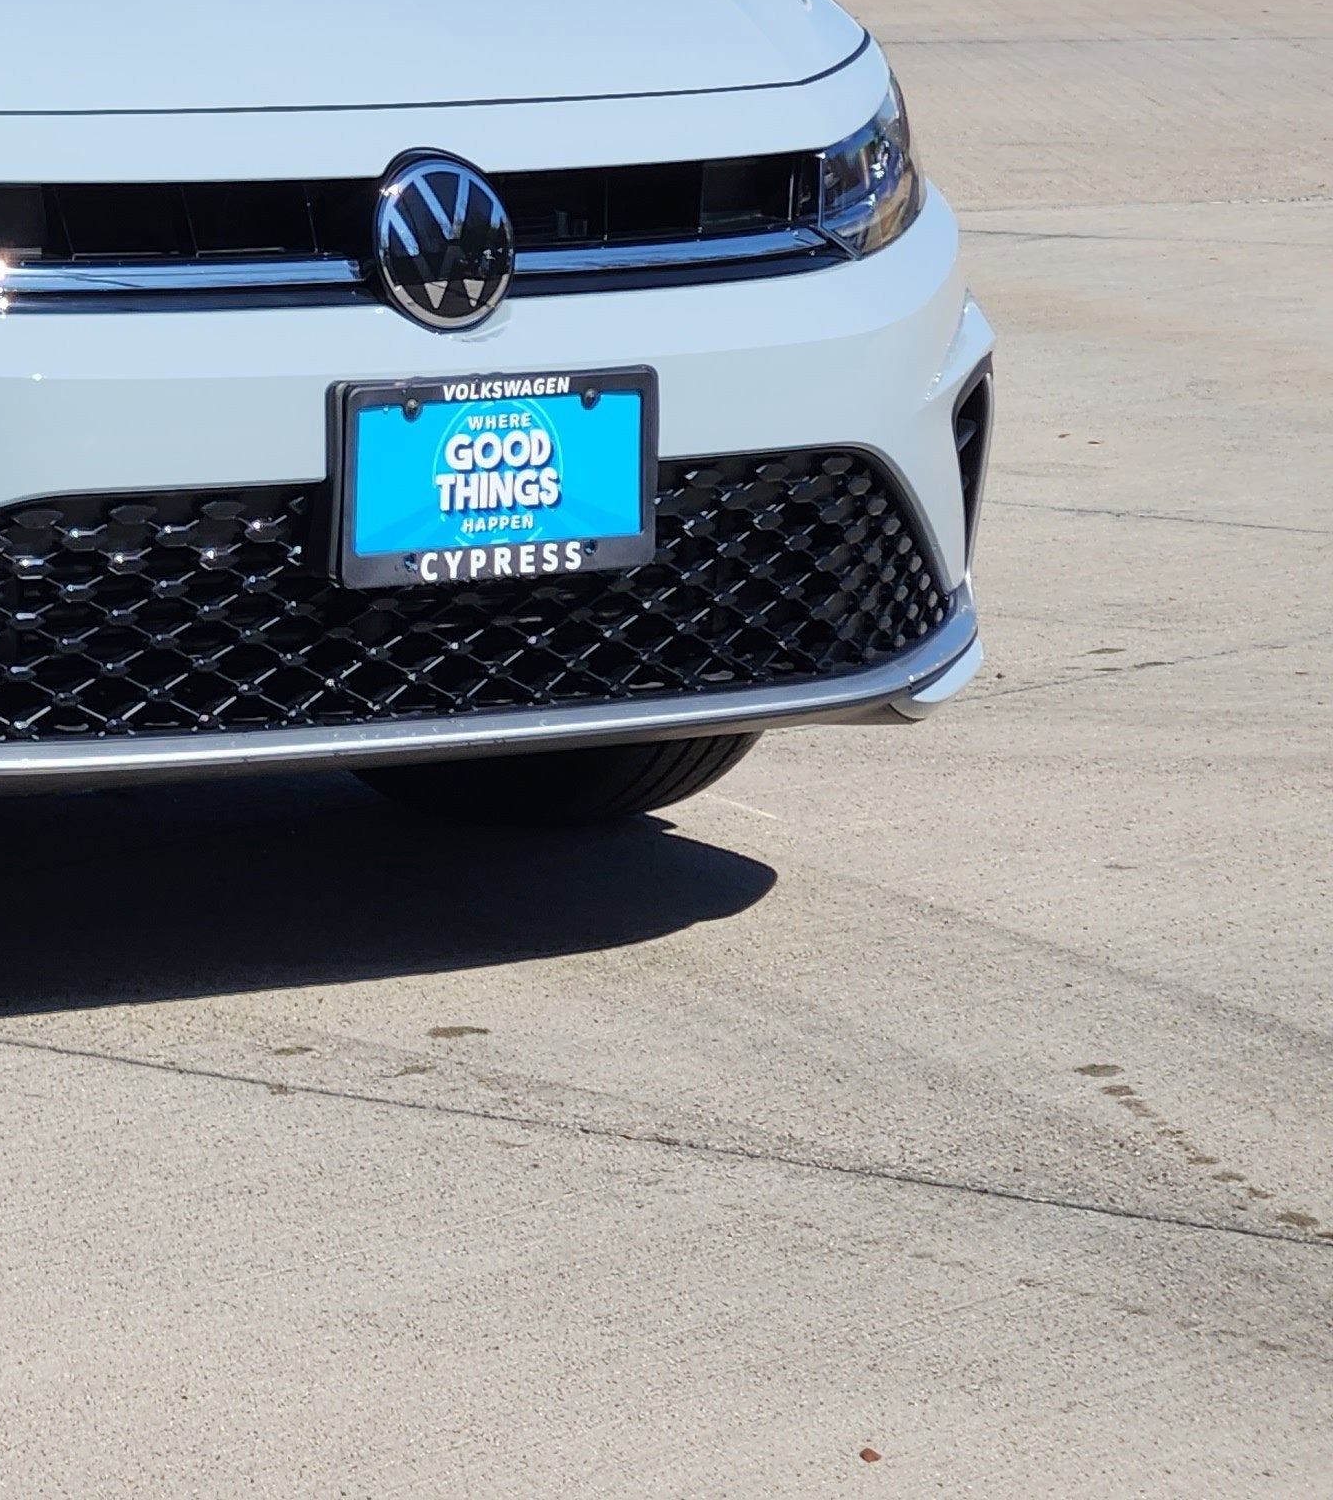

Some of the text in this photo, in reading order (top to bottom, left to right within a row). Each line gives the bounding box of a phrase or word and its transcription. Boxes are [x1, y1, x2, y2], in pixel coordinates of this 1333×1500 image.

[442, 376, 571, 401] VOLKSWAGEN
[467, 412, 533, 431] WHERE
[444, 428, 553, 471] GOOD
[435, 466, 561, 512] THINGS
[462, 513, 534, 533] HAPPEN
[419, 540, 583, 582] CYPRESS
